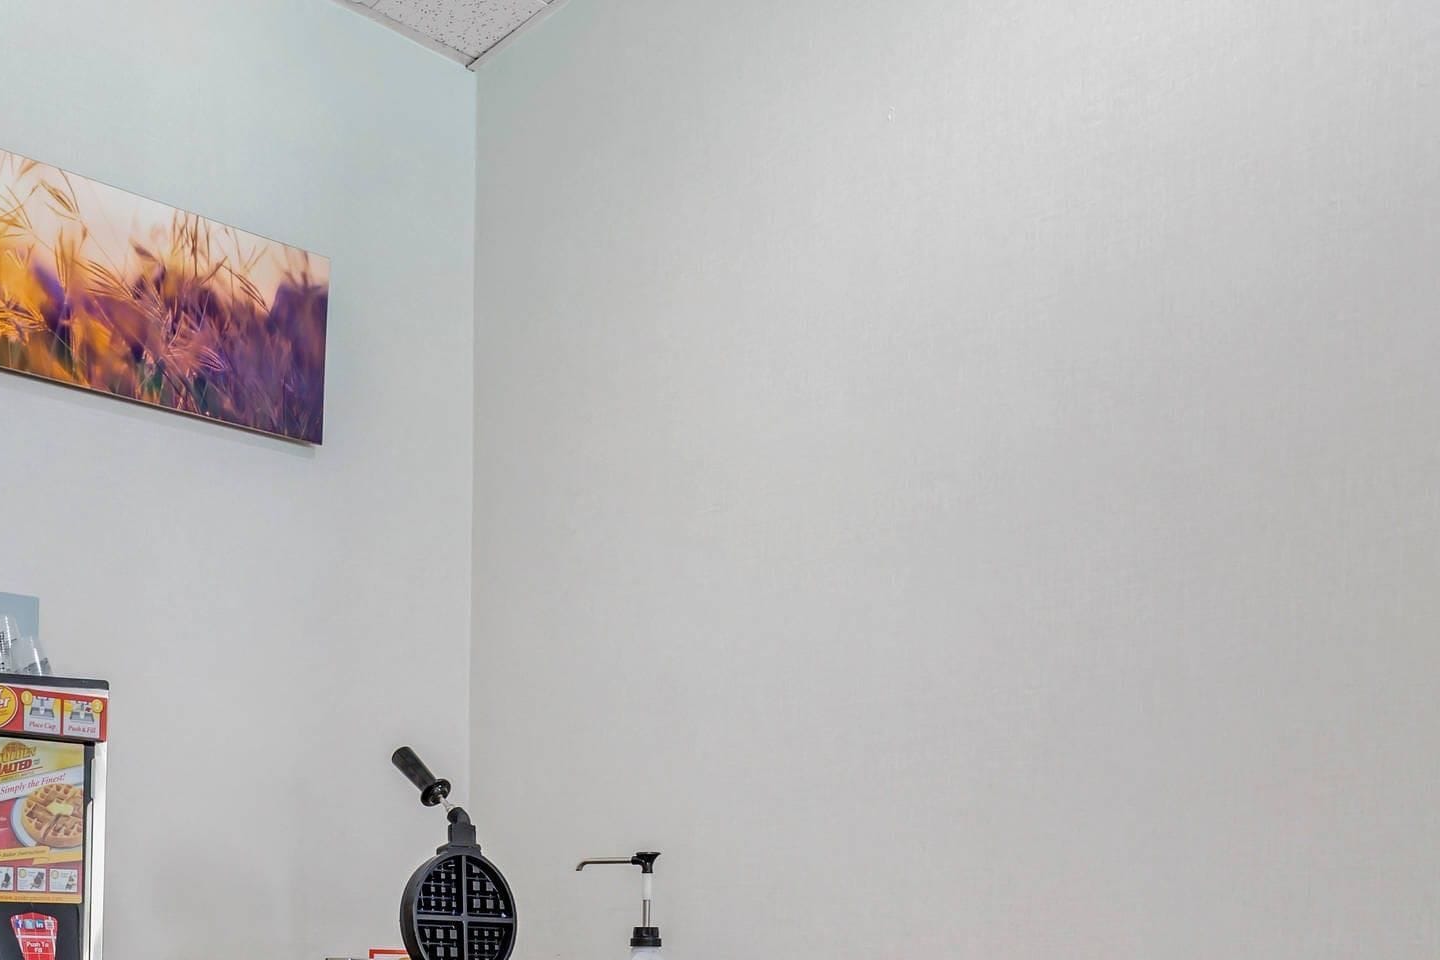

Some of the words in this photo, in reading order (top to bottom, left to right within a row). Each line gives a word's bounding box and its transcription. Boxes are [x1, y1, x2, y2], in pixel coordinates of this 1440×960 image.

[29, 721, 44, 729] Place
[0, 783, 26, 796] Simply
[27, 779, 41, 789] the
[41, 772, 67, 786] Finest!
